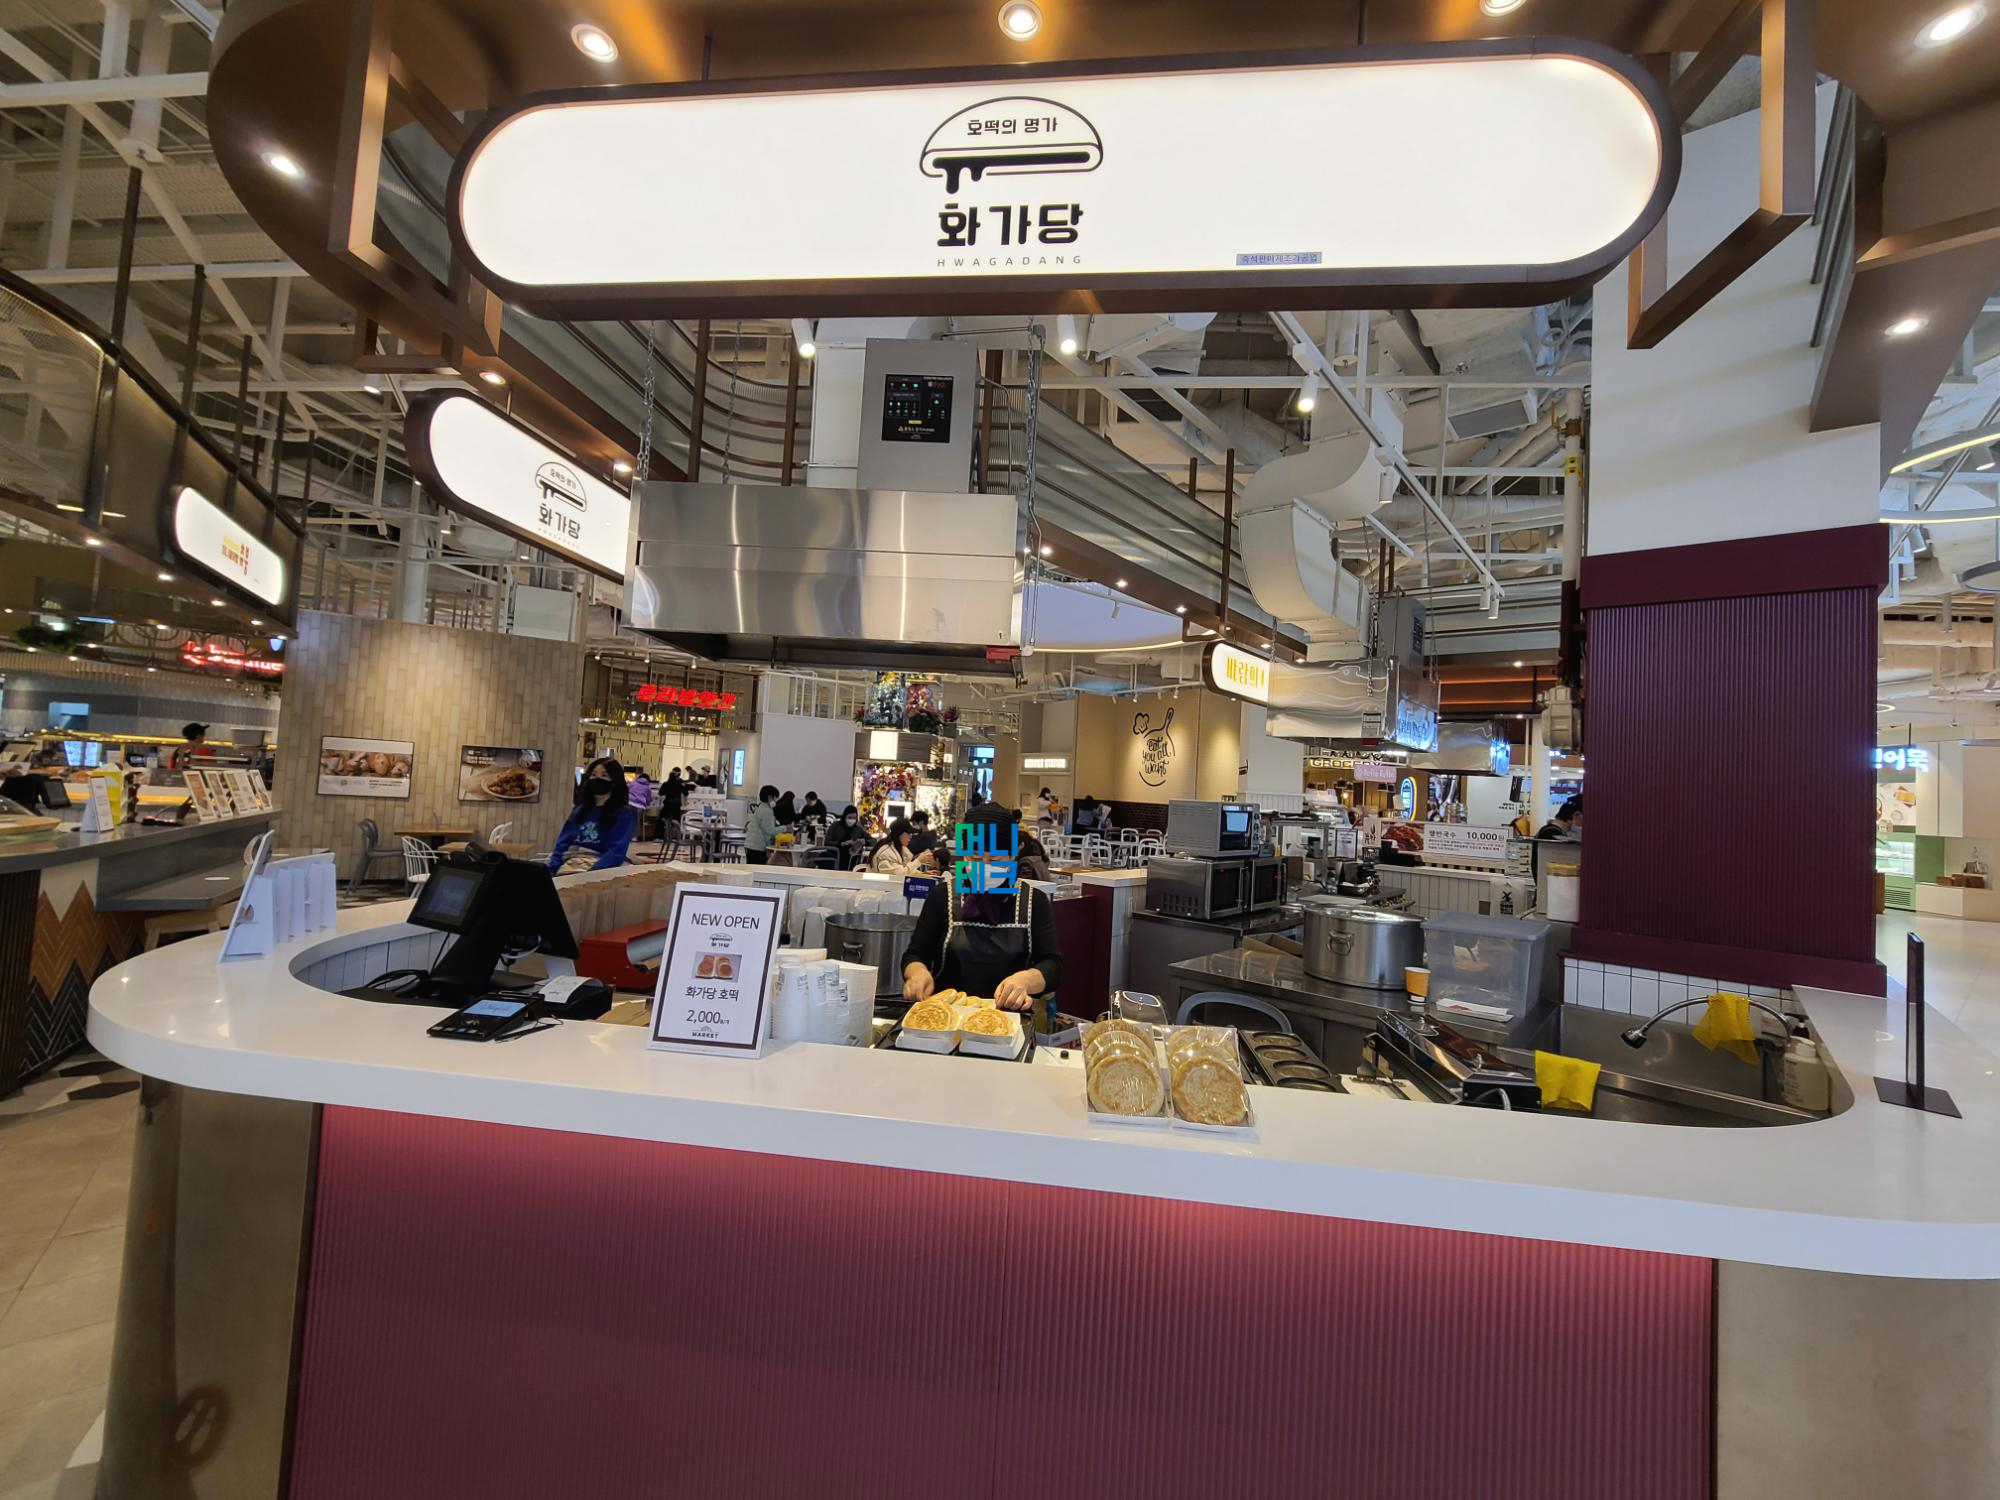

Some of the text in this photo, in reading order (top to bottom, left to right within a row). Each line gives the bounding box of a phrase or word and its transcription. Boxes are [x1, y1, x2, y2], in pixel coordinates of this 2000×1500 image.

[967, 116, 1059, 136] 호떡의 명가
[936, 202, 1084, 247] 화가당
[937, 255, 1082, 267] HWAGADANG
[539, 502, 581, 540] 화가당
[691, 913, 760, 930] NEW OPEN
[685, 986, 739, 1002] 화가당 호떡
